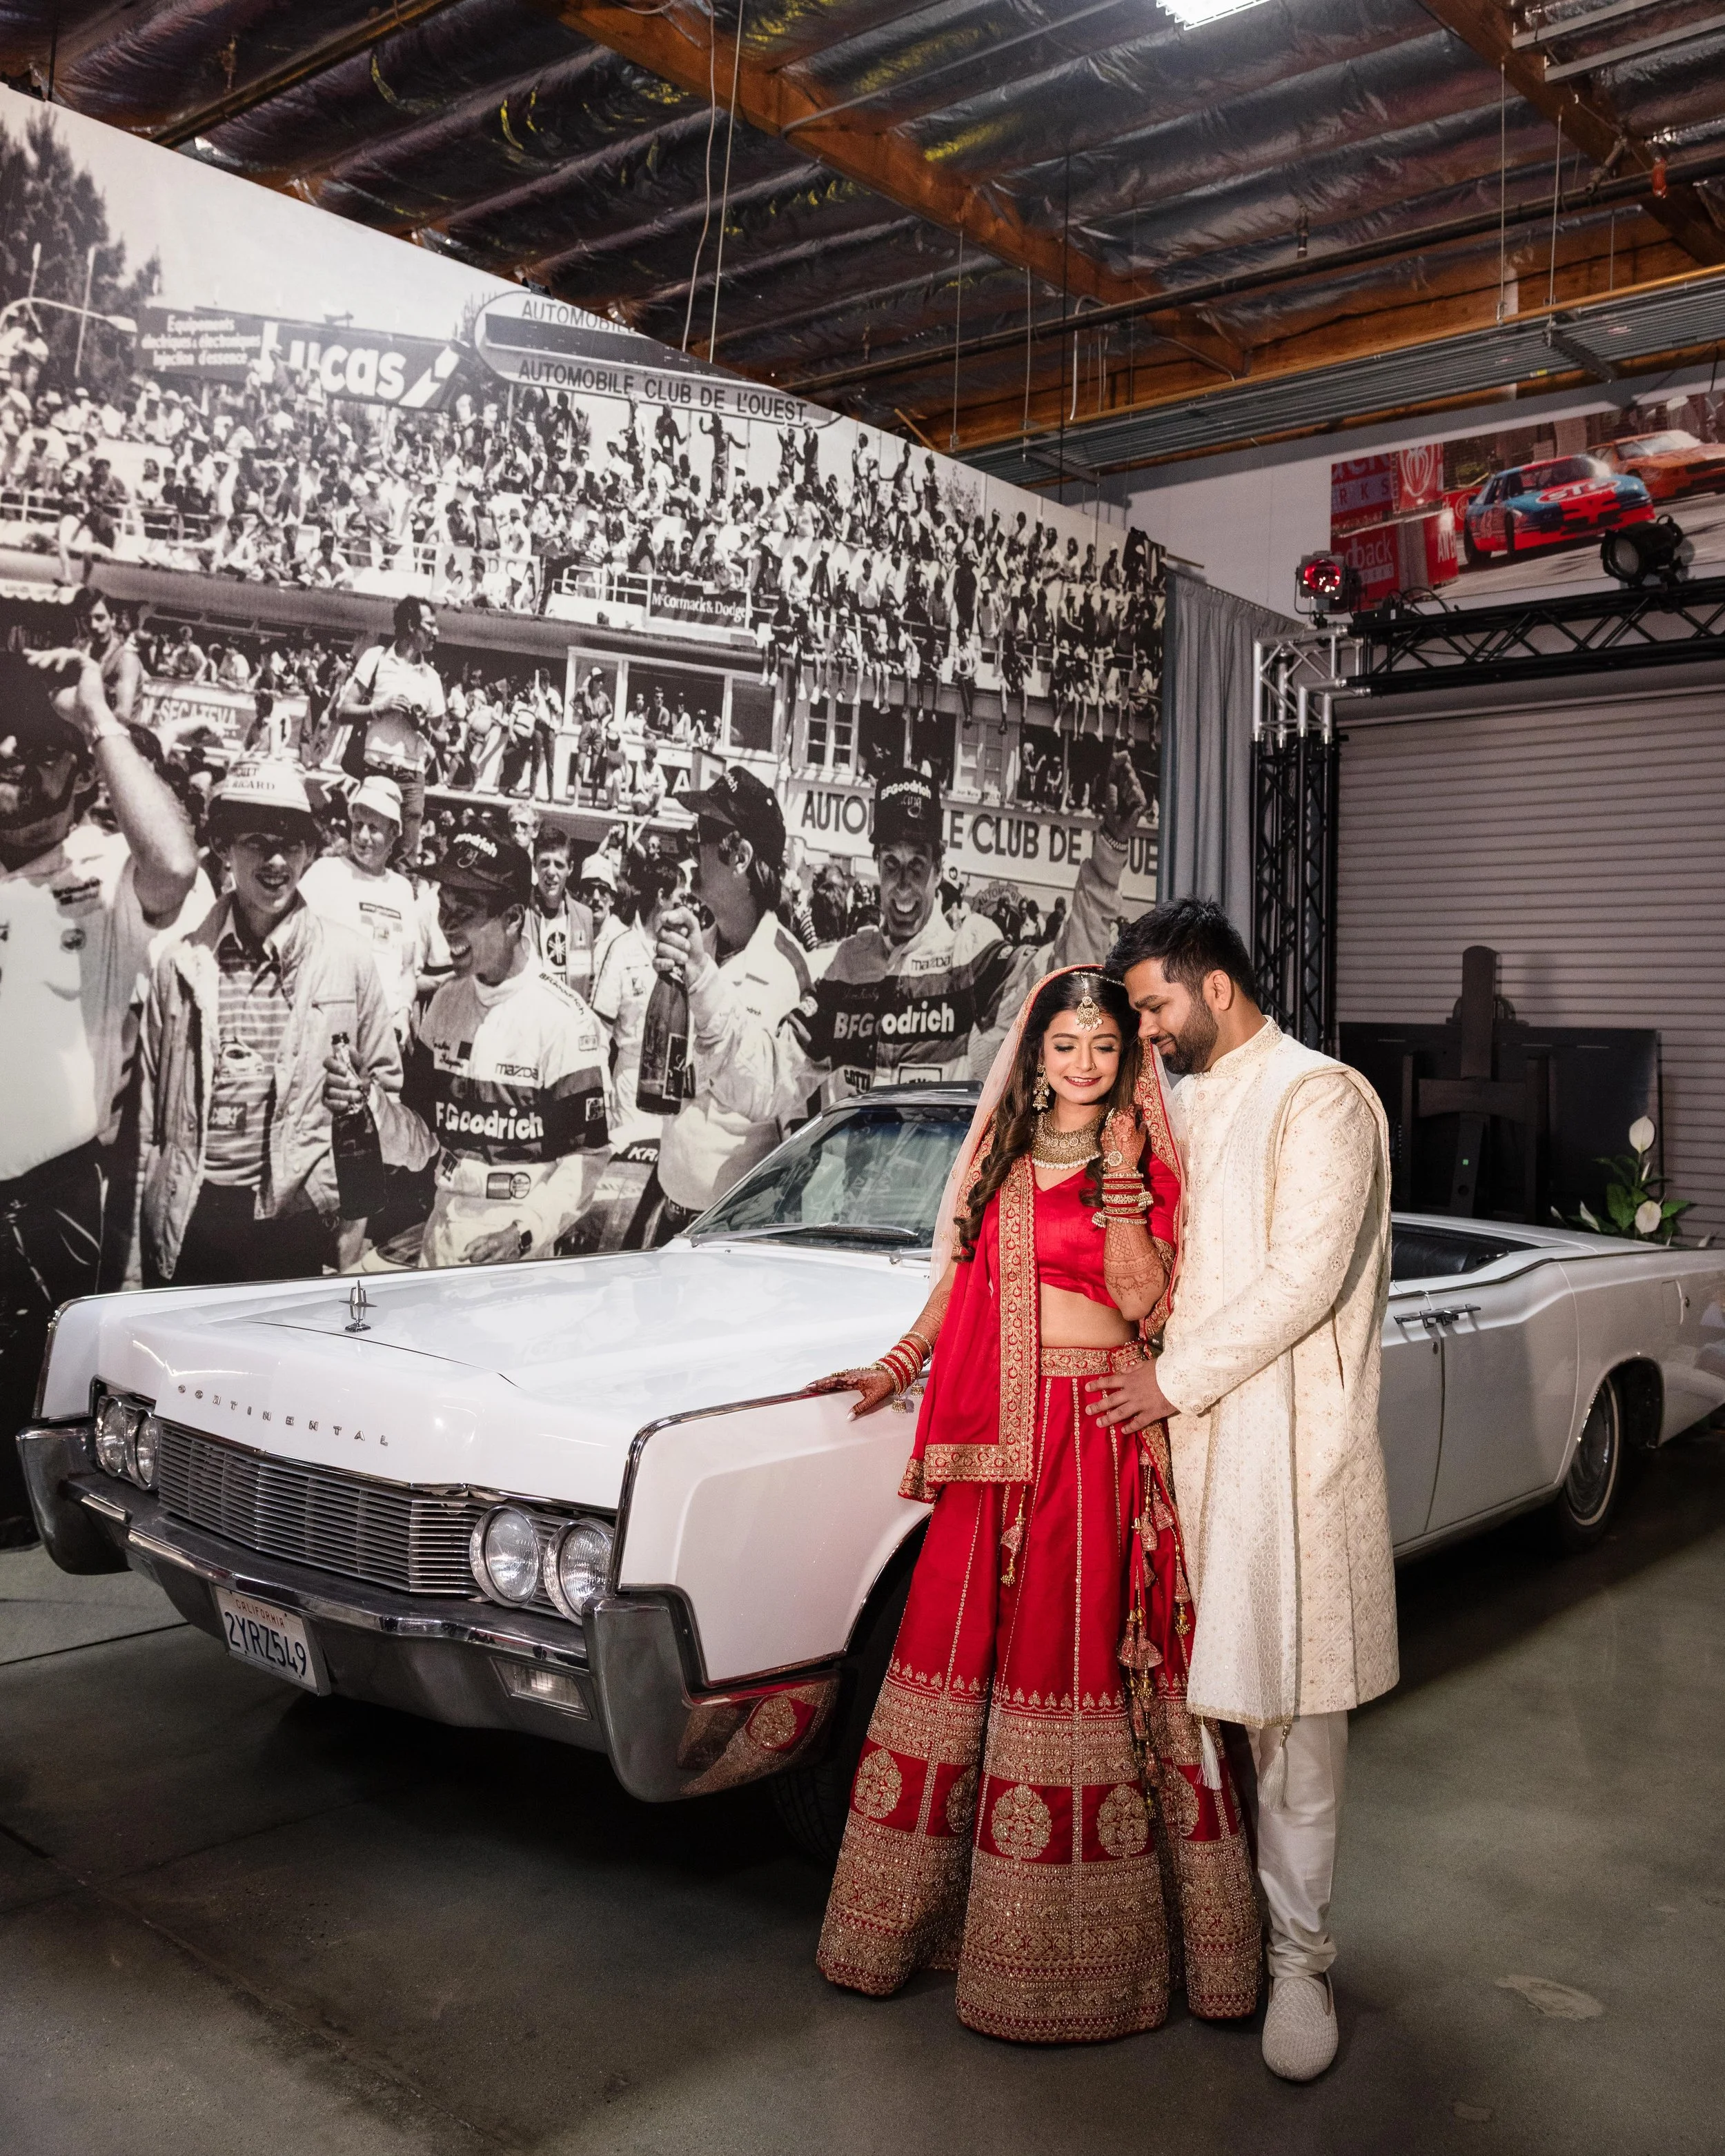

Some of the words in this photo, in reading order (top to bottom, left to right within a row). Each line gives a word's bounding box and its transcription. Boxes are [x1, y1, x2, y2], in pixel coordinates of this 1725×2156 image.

[259, 320, 406, 399] Lucas
[519, 359, 634, 395] AUTOMOBILE
[644, 379, 691, 404] CLUB
[700, 387, 725, 410] DE
[737, 392, 807, 422] L'OUEST
[715, 600, 747, 622] Dodge
[880, 780, 931, 801] BFGoodrich
[972, 813, 1040, 860] CLUB
[1049, 823, 1083, 865] DE
[177, 1384, 388, 1447] CONTINENTAL
[235, 1599, 285, 1629] CALIFORNIA
[224, 1611, 307, 1677] 2YRZ549
